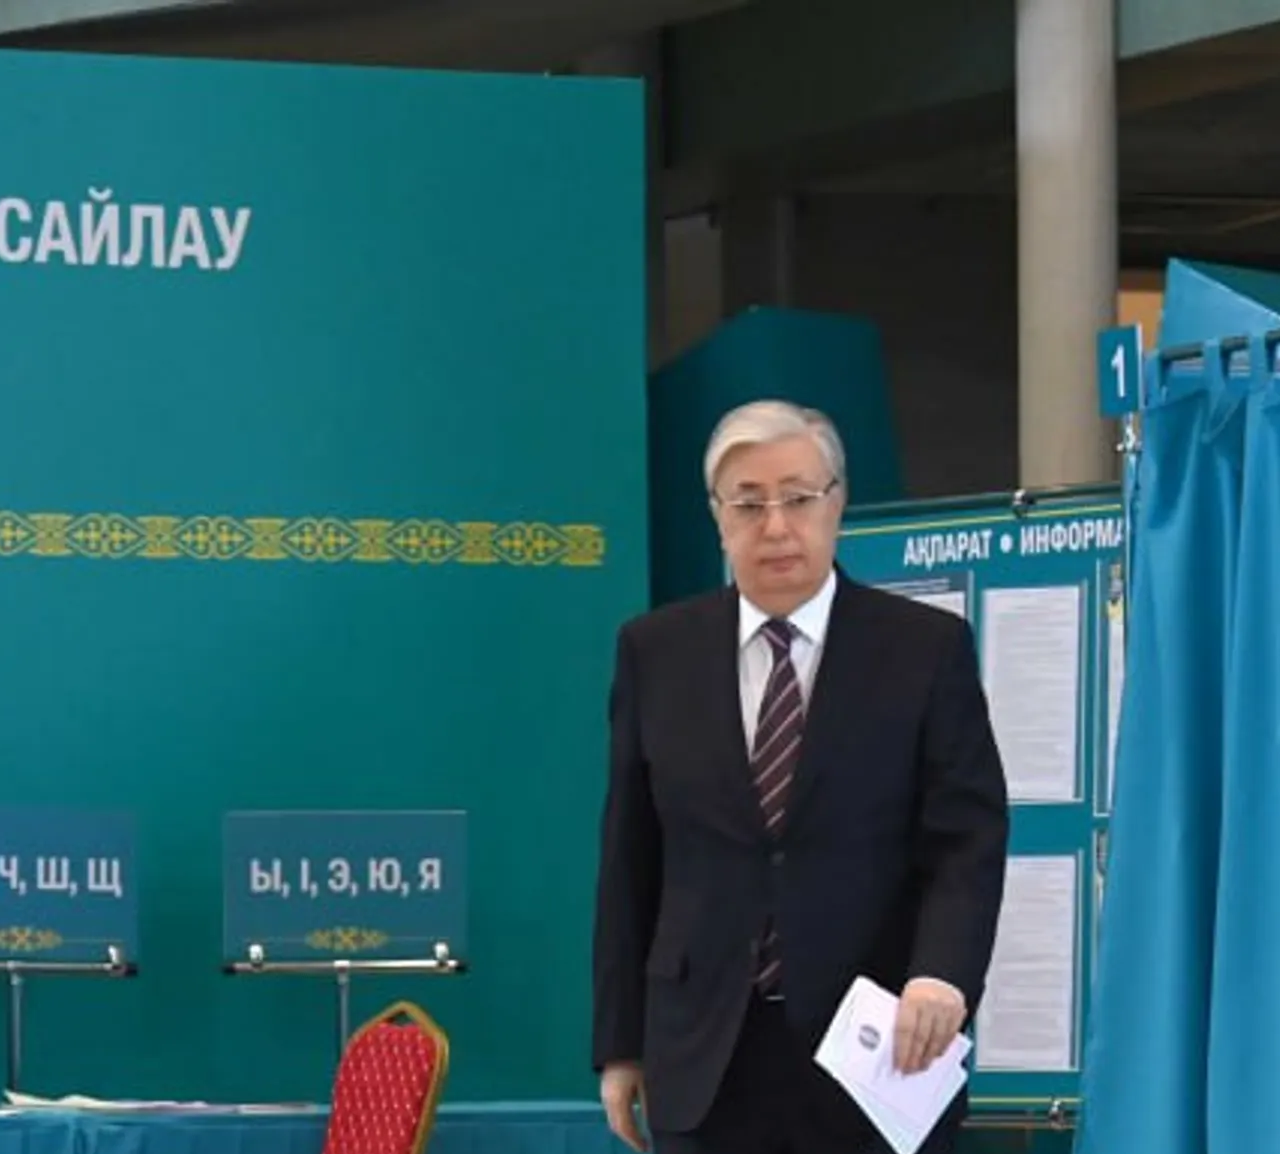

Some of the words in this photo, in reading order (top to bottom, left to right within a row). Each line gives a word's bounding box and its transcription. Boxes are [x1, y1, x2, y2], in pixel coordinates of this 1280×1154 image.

[1111, 344, 1125, 398] 1
[903, 528, 993, 570] АҚПАРАТ
[36, 856, 78, 897] Ш,
[87, 857, 123, 898] Щ
[249, 858, 290, 898] Ы,
[368, 857, 410, 898] Ю,
[418, 857, 441, 891] Я
